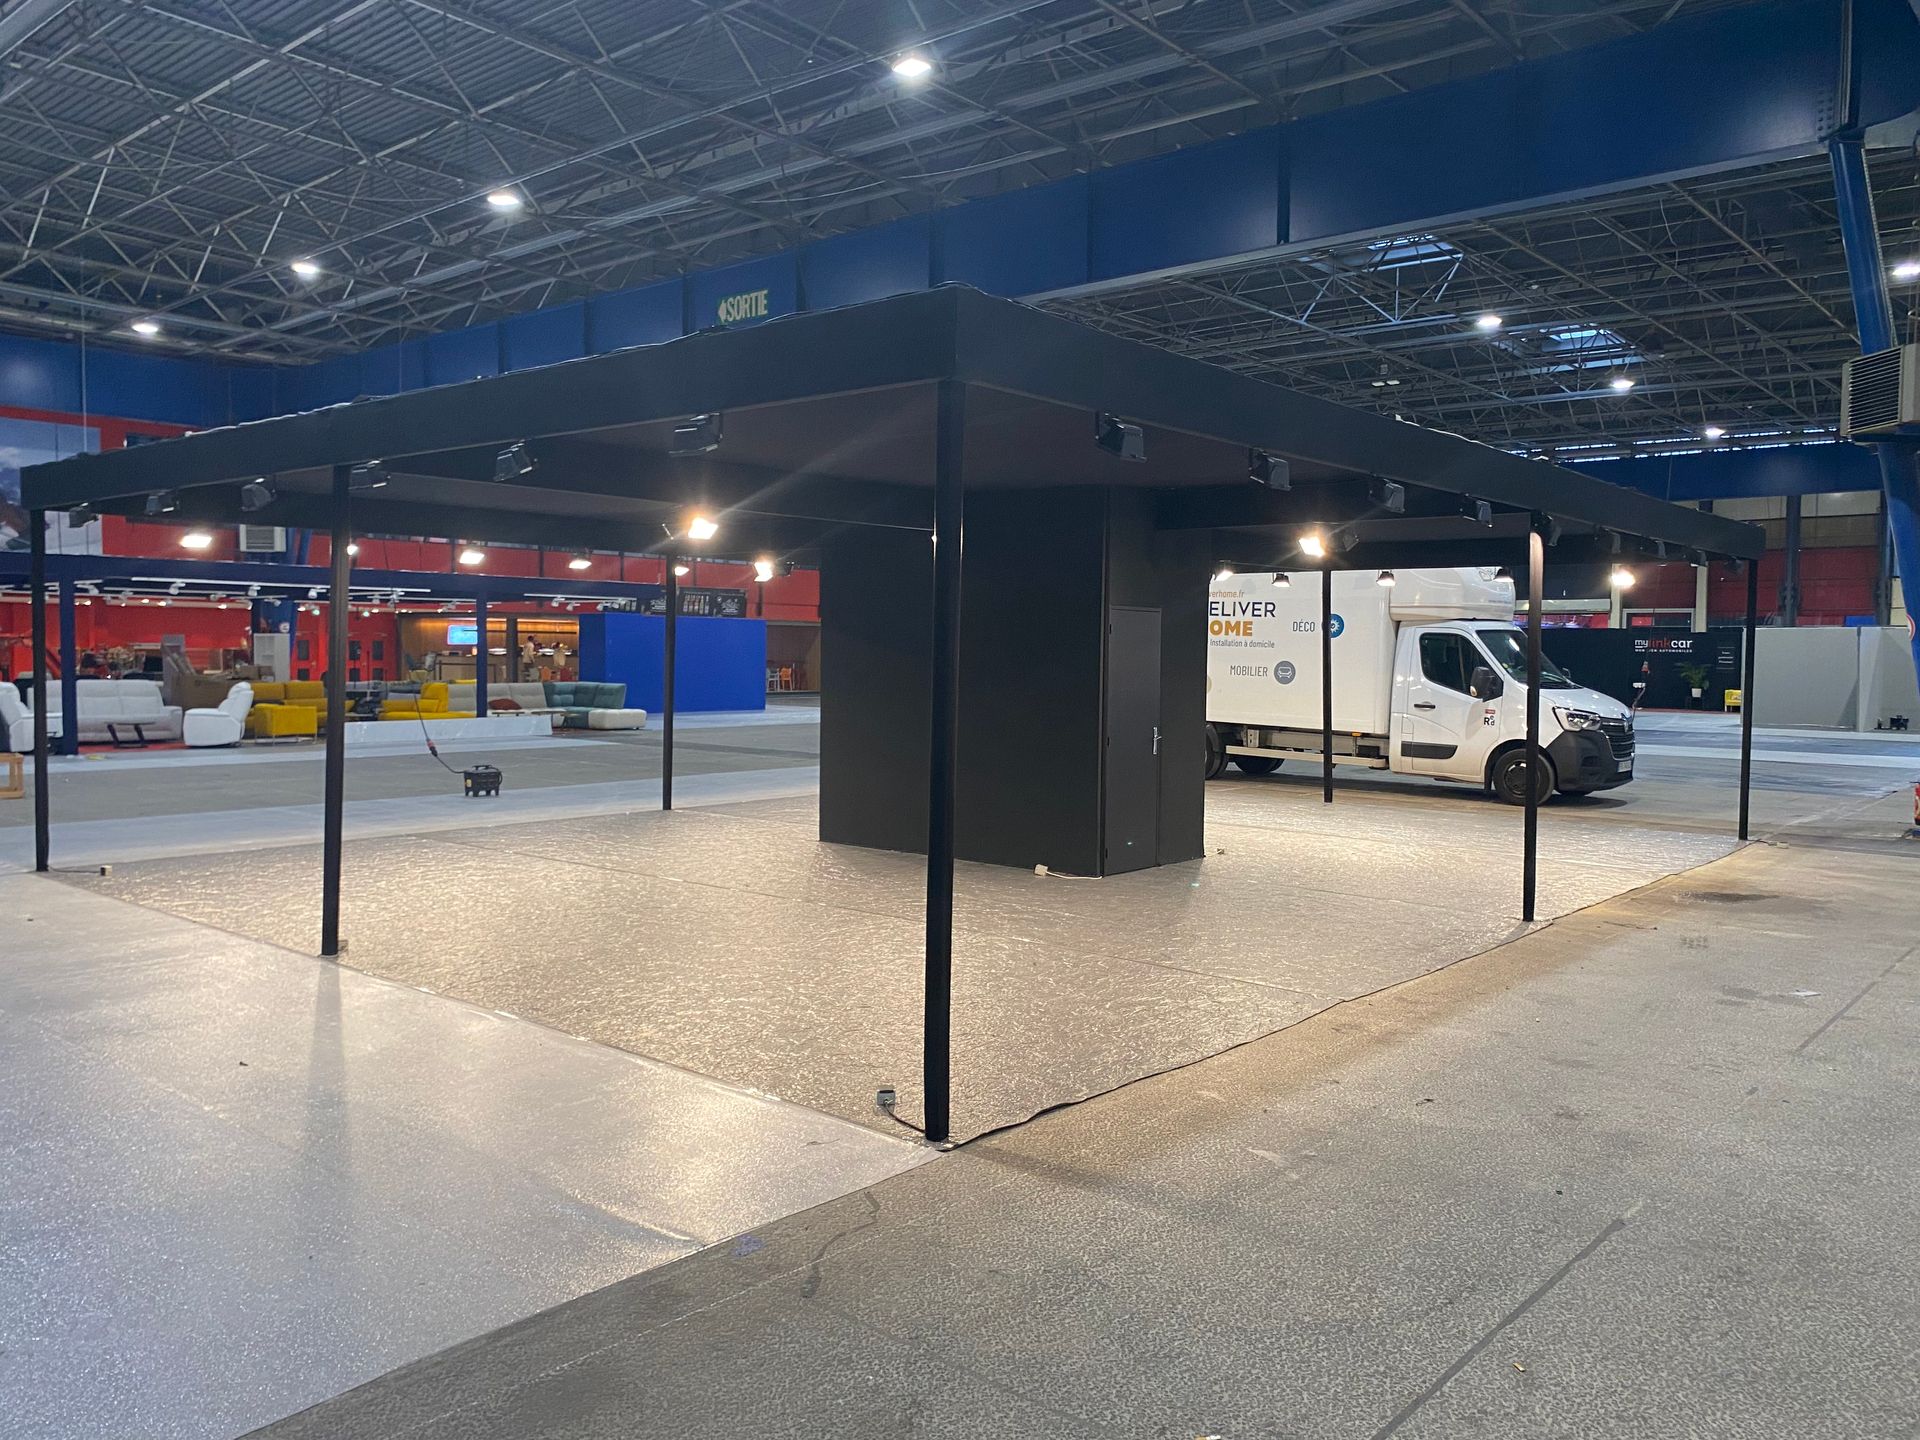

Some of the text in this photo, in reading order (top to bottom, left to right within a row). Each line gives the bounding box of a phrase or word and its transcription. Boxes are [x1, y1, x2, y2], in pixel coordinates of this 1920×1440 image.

[727, 289, 768, 322] SORTIE
[1209, 601, 1276, 617] ELIVER
[1209, 620, 1253, 636] OME
[1292, 619, 1316, 632] DÉCO
[1249, 640, 1275, 648] domicile
[1634, 638, 1693, 648] mylinkcar
[1229, 665, 1269, 677] MOBILIER
